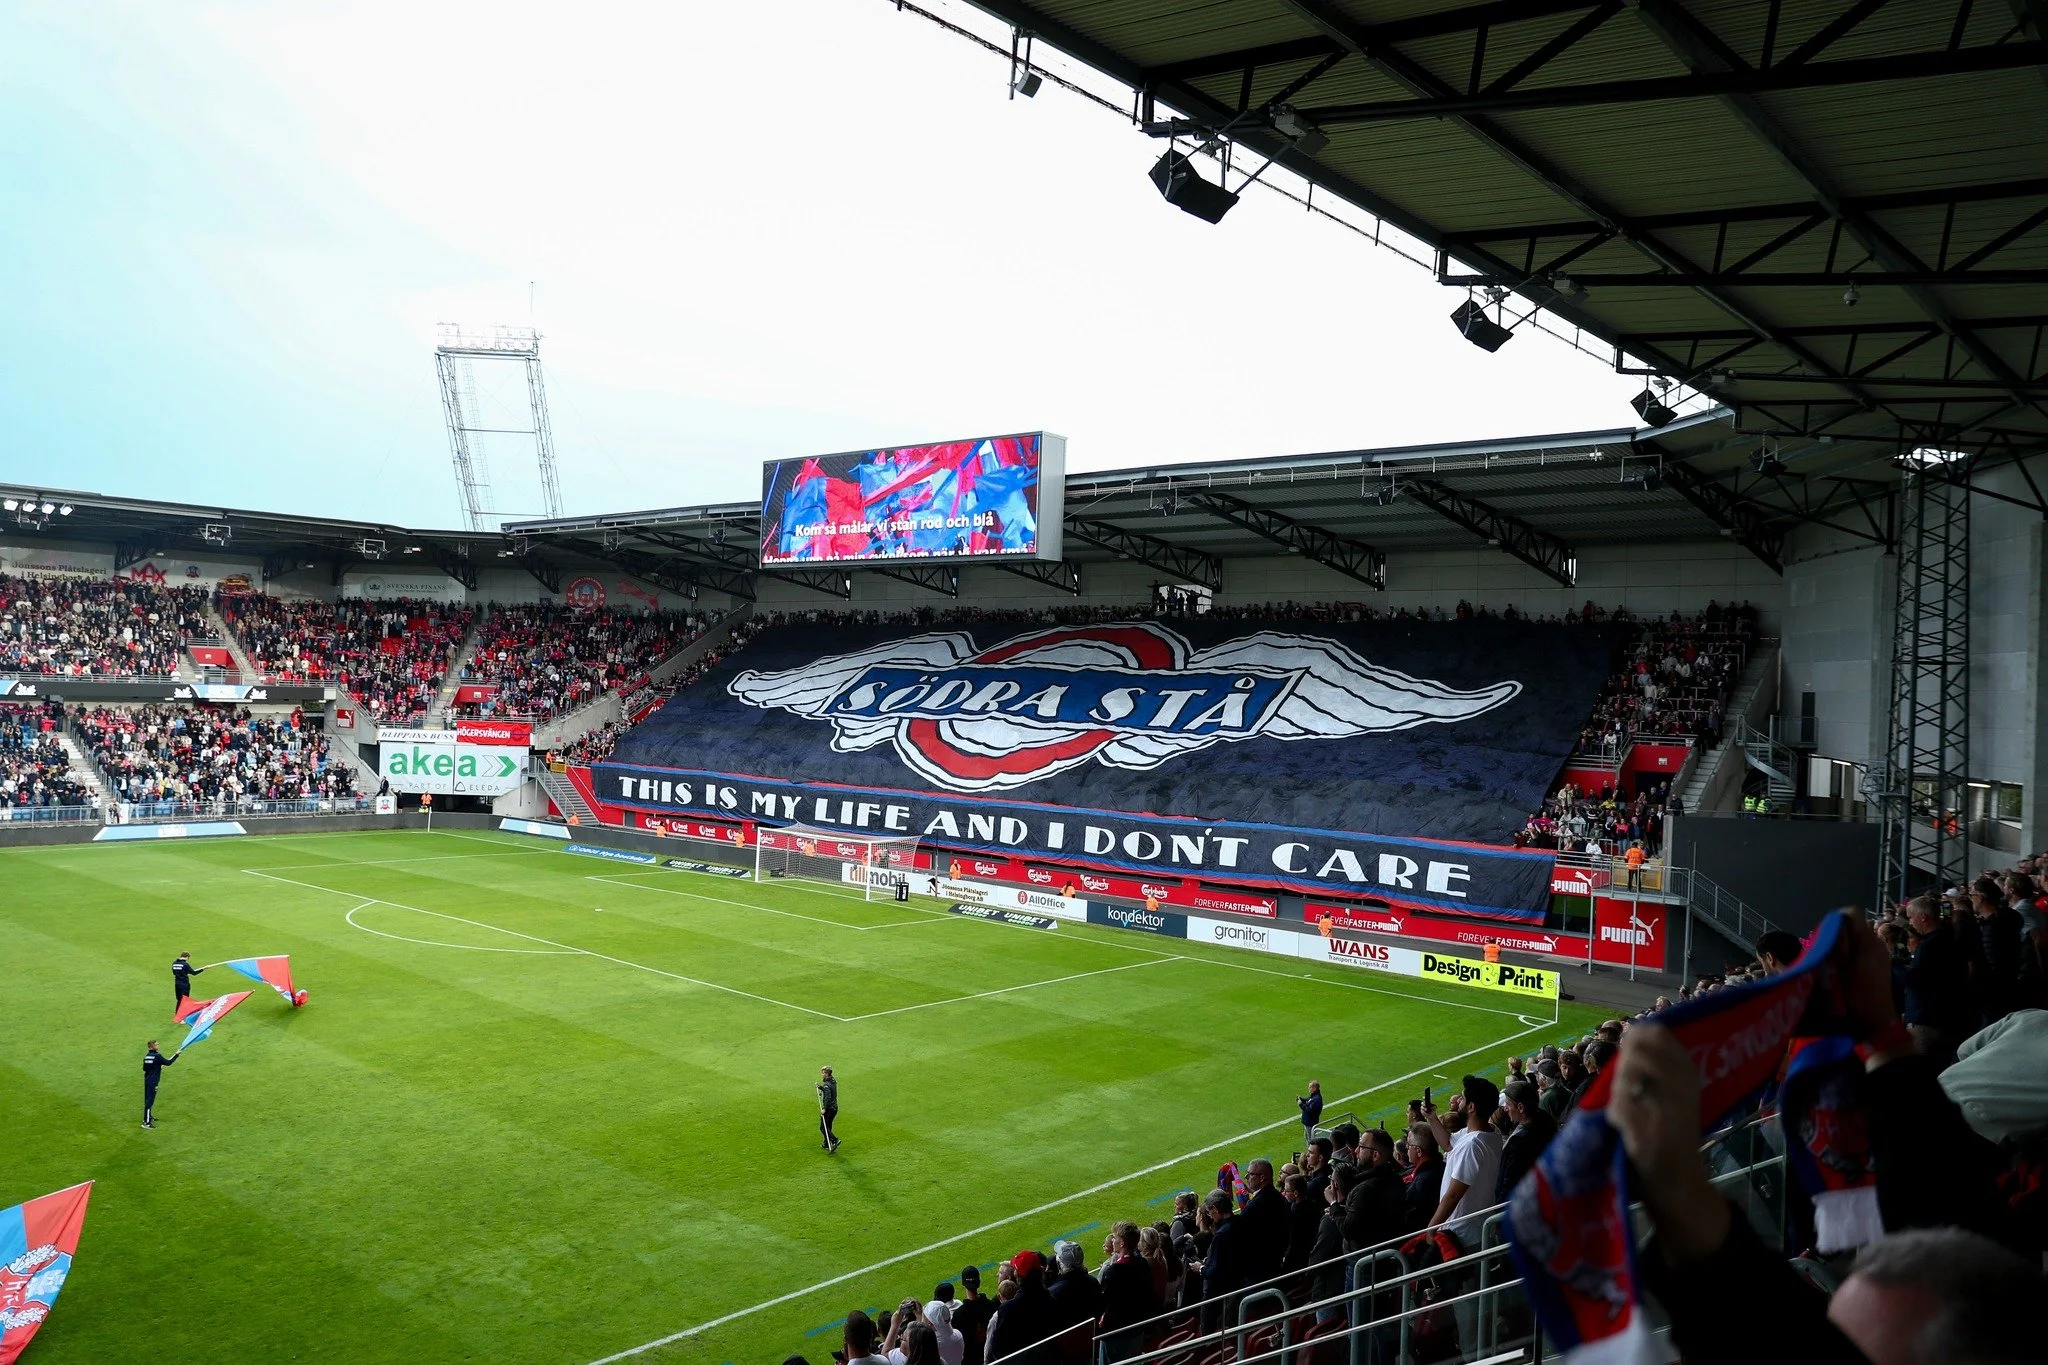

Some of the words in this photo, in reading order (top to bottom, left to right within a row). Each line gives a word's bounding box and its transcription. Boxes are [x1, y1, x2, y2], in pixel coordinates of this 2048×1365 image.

[795, 523, 821, 537] Kom
[824, 521, 836, 535] så
[840, 520, 872, 534] målar
[876, 520, 888, 532] vi
[890, 518, 917, 532] stan
[920, 514, 943, 530] röd
[946, 514, 970, 528] och
[973, 511, 994, 526] blå
[131, 562, 169, 584] MAX
[836, 674, 1069, 718] SÖDRA
[1088, 676, 1256, 731] STÅ
[456, 728, 511, 738] HÖGERSVÄNGEN
[389, 746, 478, 778] akea
[618, 776, 693, 806] THIS
[706, 784, 738, 810] IS
[752, 792, 802, 820] MY
[814, 798, 911, 831] LIFE
[924, 810, 1028, 846] AND
[1048, 822, 1065, 849] I
[1271, 842, 1471, 898] CARE
[974, 862, 998, 876] Carlsberg
[1028, 868, 1052, 882] Carlsberg
[1082, 874, 1110, 891] Carlsberg
[1141, 884, 1170, 899] Carlsberg
[1554, 880, 1588, 894] PUMA
[1028, 894, 1066, 909] AllOffice
[958, 904, 1000, 916] UNIBET
[1004, 912, 1048, 924] UNIBET
[1108, 906, 1165, 927] kondektor
[1214, 925, 1266, 942] granitor
[1600, 926, 1646, 946] PUMA
[1329, 938, 1389, 960] WANS
[1328, 954, 1352, 964] Transport
